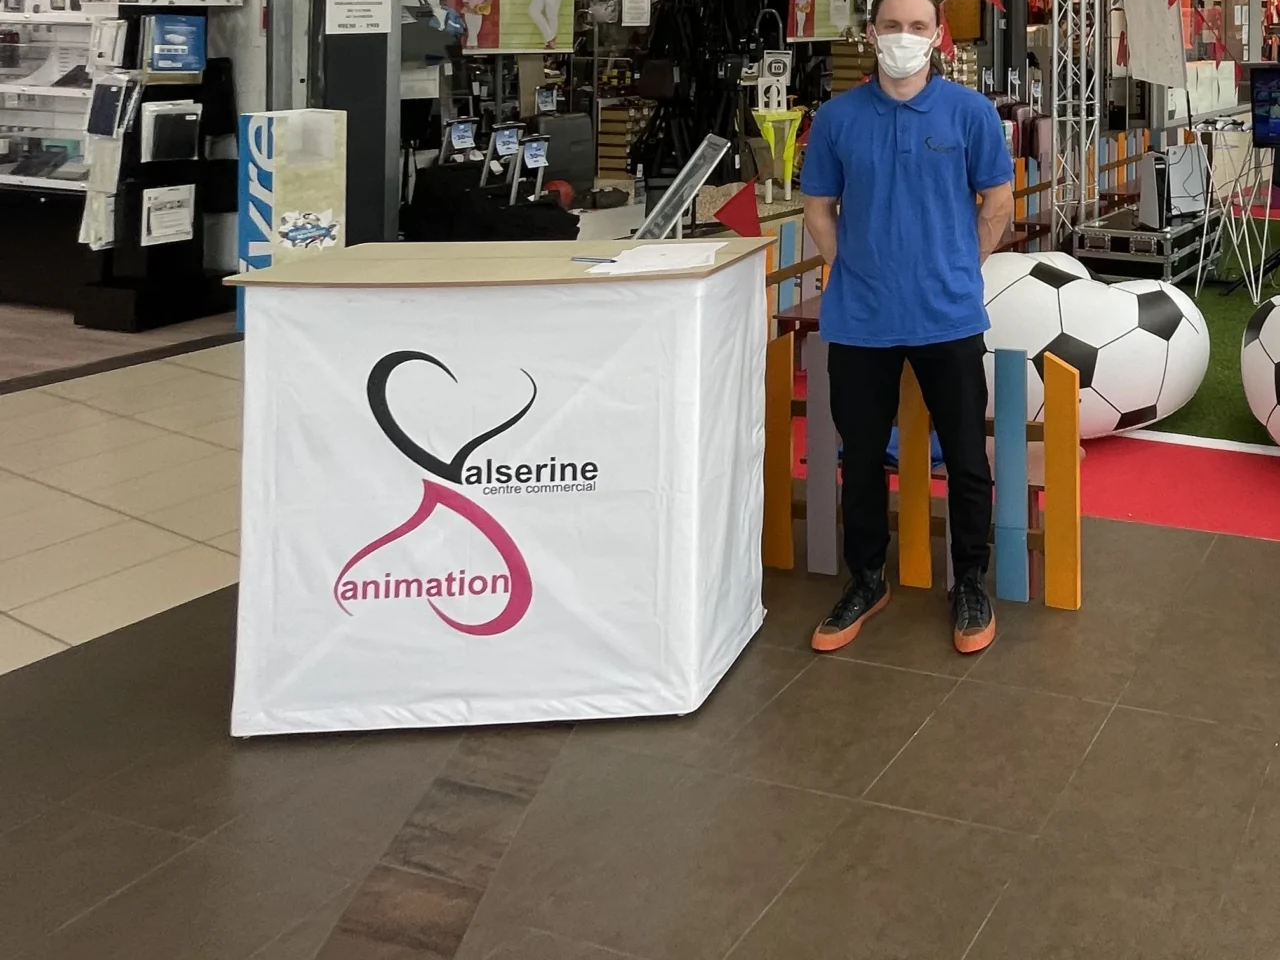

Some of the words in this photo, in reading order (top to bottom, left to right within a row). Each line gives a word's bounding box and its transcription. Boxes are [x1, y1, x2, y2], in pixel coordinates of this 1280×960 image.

[482, 483, 522, 495] centre
[525, 480, 596, 493] commercial
[340, 569, 509, 602] animation
